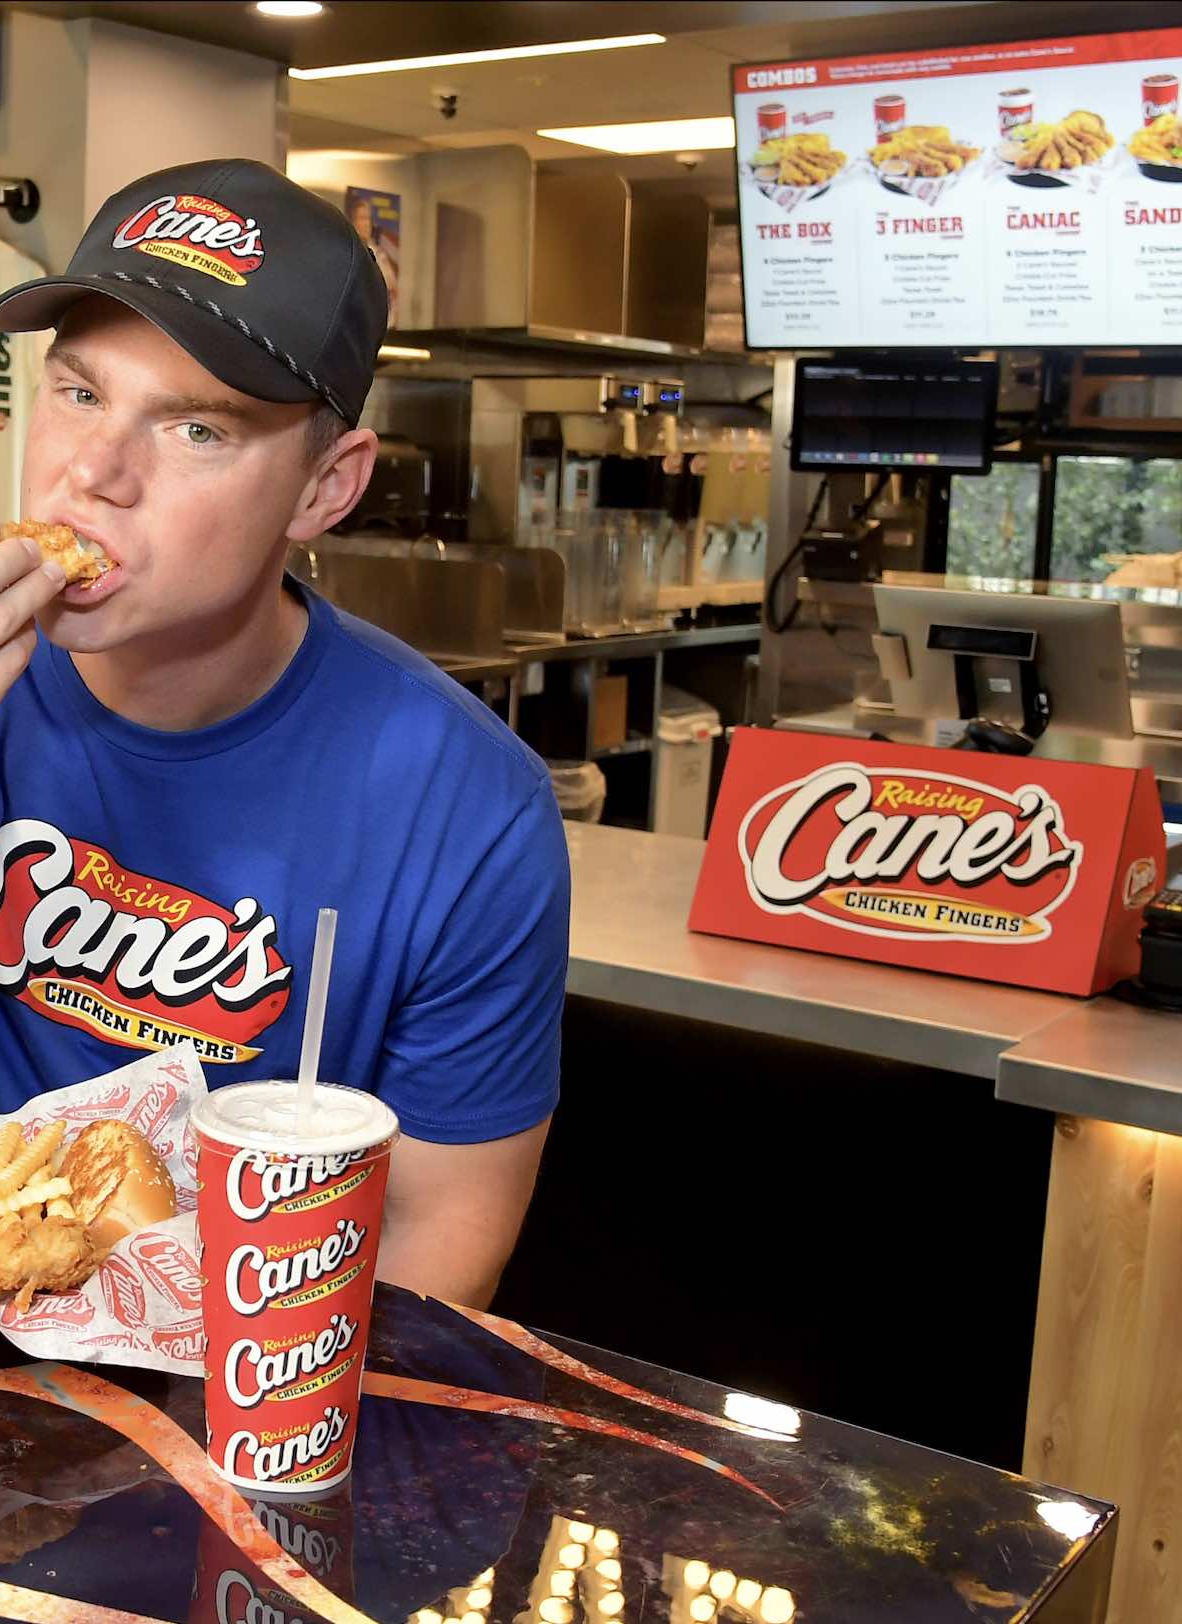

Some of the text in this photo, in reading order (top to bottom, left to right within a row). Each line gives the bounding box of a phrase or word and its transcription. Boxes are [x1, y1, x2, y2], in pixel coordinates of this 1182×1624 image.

[747, 66, 818, 88] COMBOS
[177, 195, 232, 221] Raising
[1006, 211, 1081, 230] CANIAC
[113, 195, 265, 258] Cane's
[756, 222, 832, 240] THE BOX
[876, 216, 963, 236] 3 FINGER
[873, 779, 985, 819] Raising
[751, 766, 1076, 906] Cane's
[77, 850, 193, 923] Raising
[265, 1235, 322, 1259] Raising
[226, 1219, 367, 1316] Cane's
[262, 1330, 317, 1353] Raising
[224, 1313, 358, 1408] Cane's
[223, 1406, 349, 1482] Cane's
[259, 1422, 311, 1445] Raising
